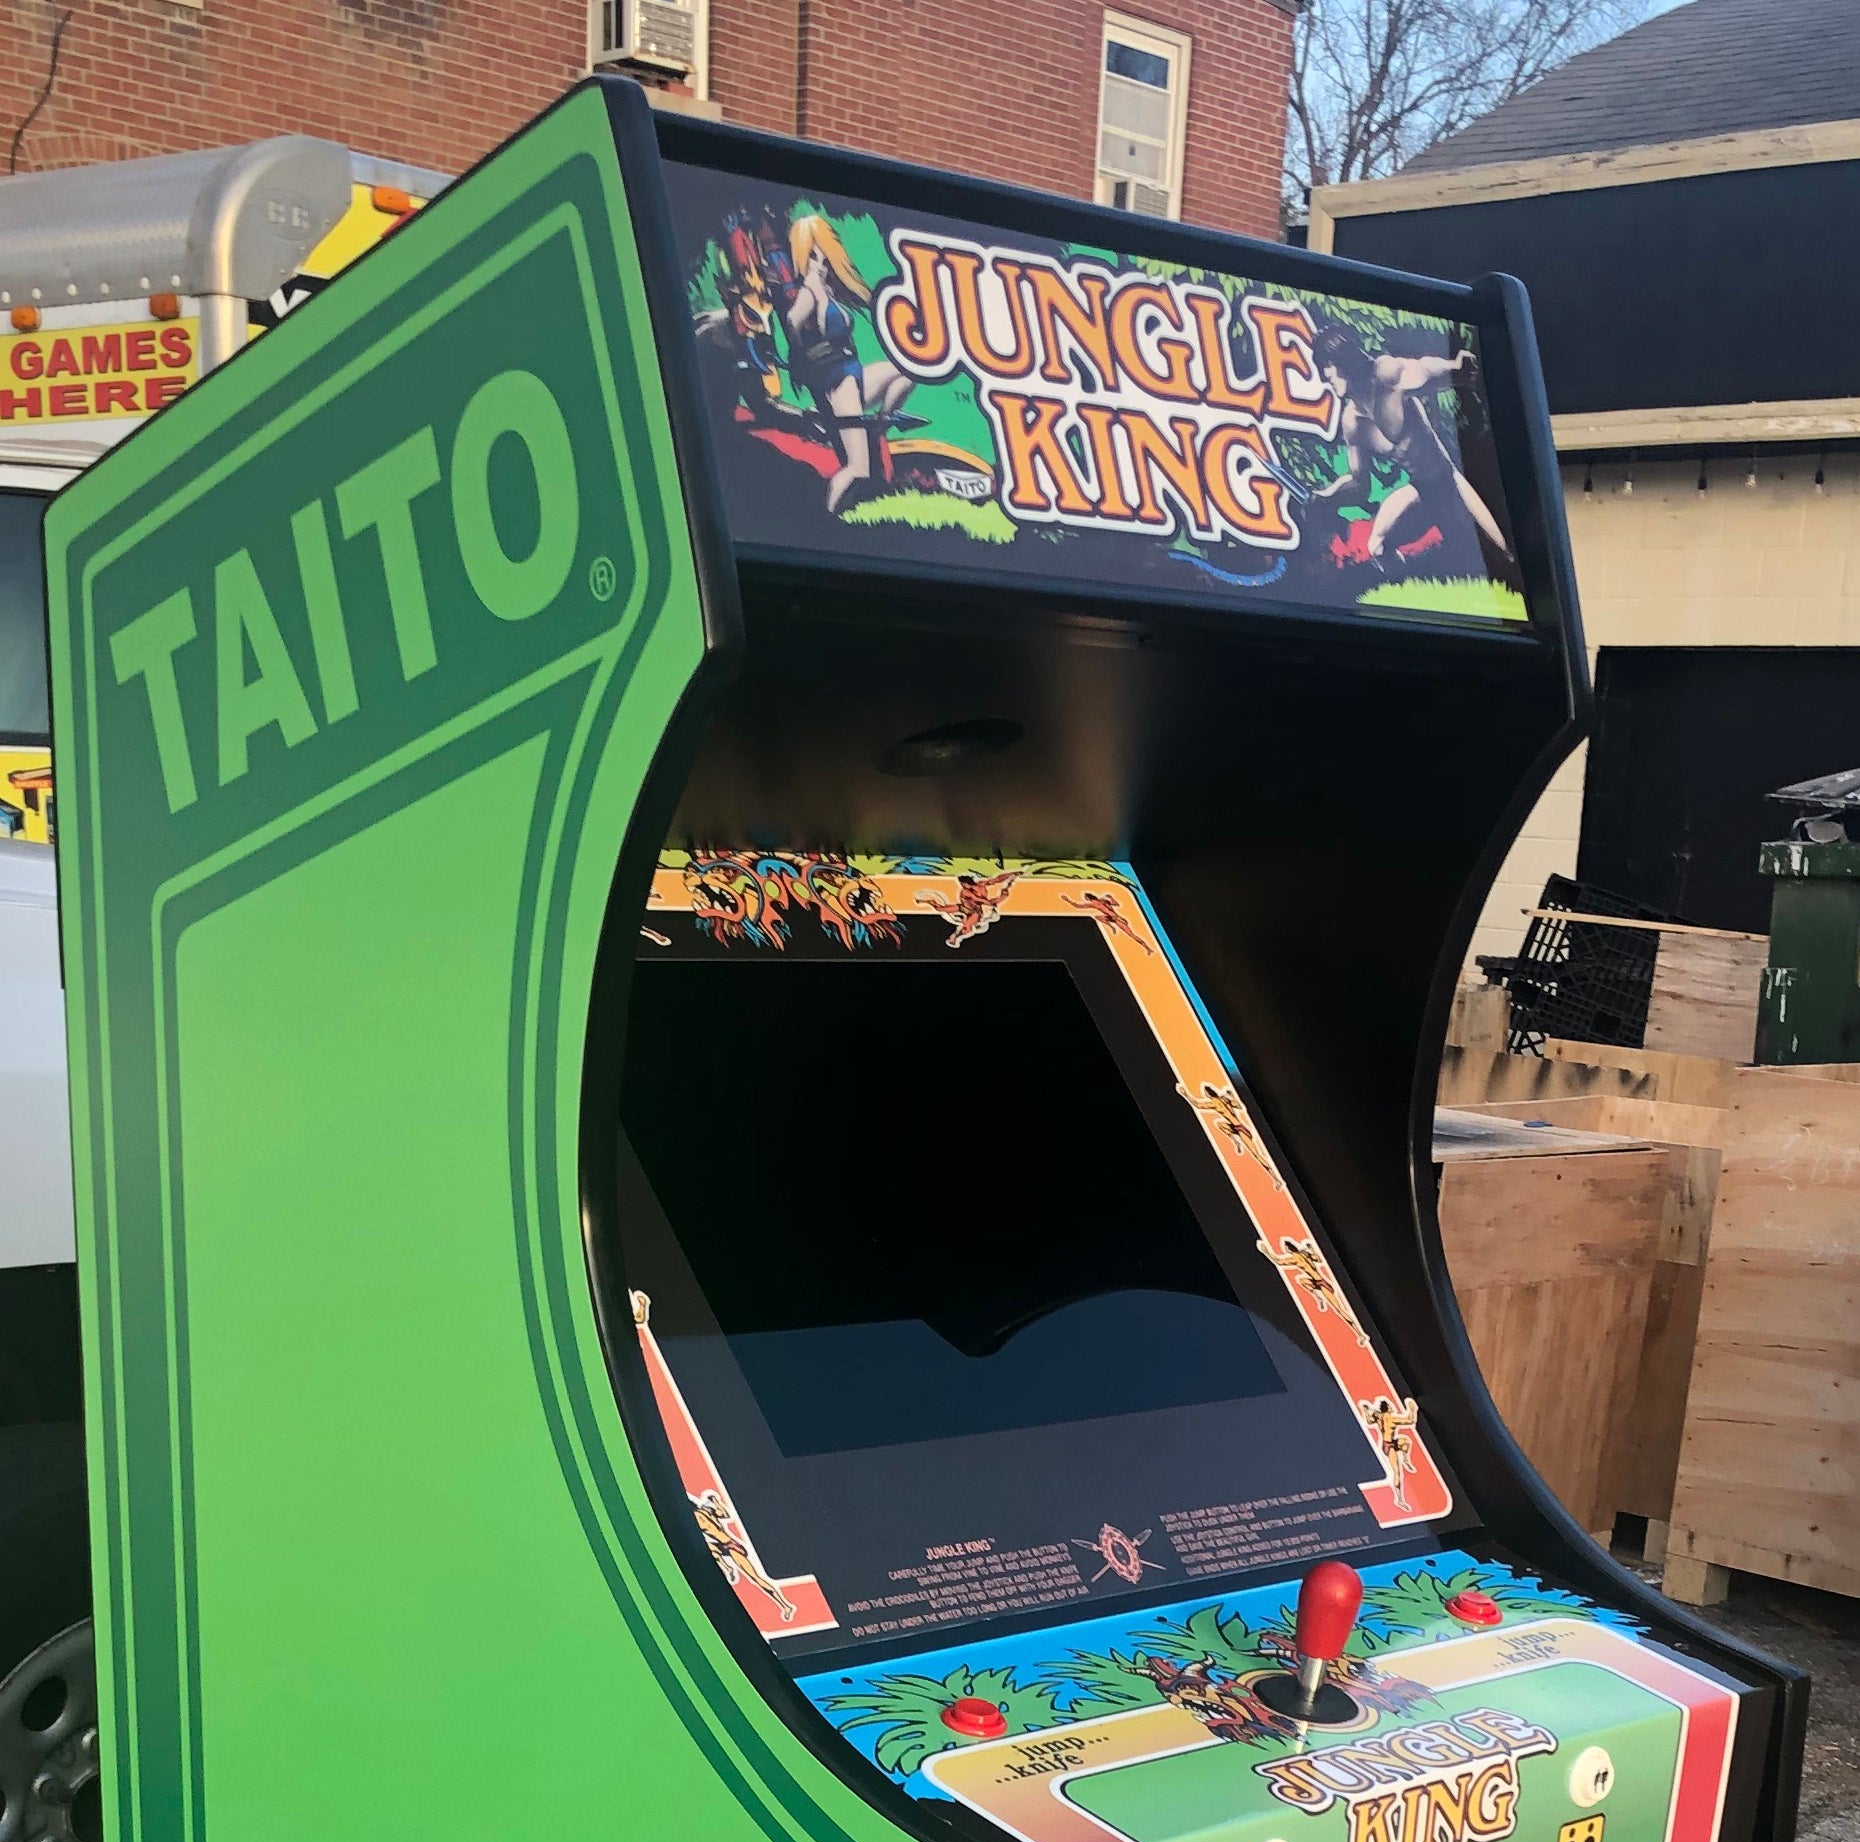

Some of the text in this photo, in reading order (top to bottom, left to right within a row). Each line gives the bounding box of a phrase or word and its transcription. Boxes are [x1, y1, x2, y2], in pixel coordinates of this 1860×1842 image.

[10, 327, 193, 381] GAMES
[884, 241, 1336, 429] JUNGLE
[0, 375, 187, 420] HERE
[945, 477, 986, 496] TAITO
[988, 391, 1294, 540] KING
[109, 368, 580, 816] TAITO
[925, 1543, 966, 1560] JUNGLE
[1261, 1709, 1554, 1805] JUNGLE
